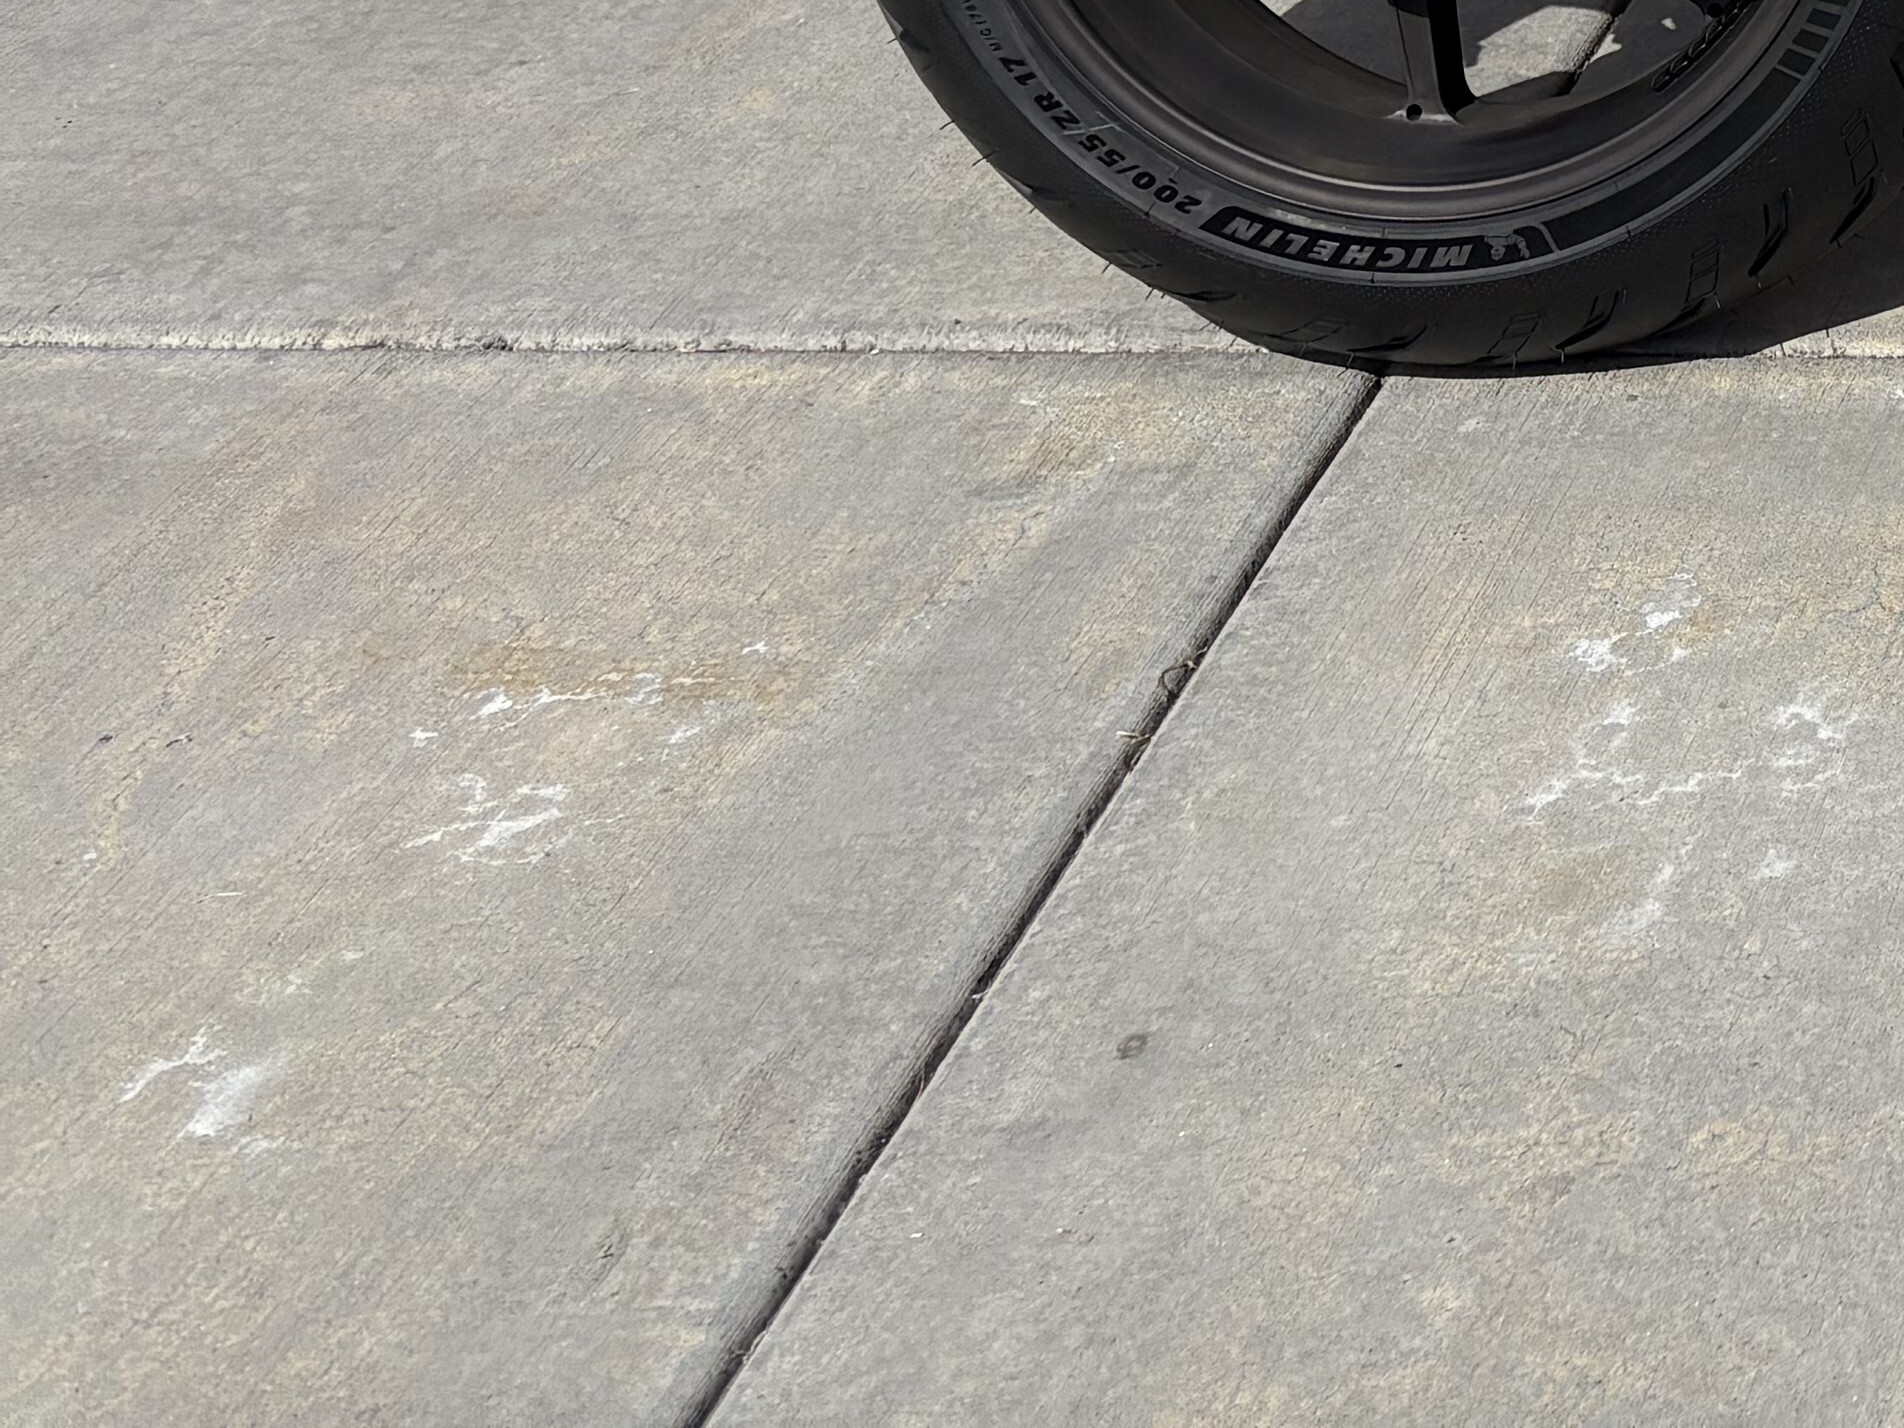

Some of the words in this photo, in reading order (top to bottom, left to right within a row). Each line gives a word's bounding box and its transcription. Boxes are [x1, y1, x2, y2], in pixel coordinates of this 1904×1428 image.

[999, 56, 1037, 86] 17
[1034, 91, 1081, 130] ZR
[1078, 134, 1202, 214] 200/55
[1221, 216, 1473, 269] MICHELIN
